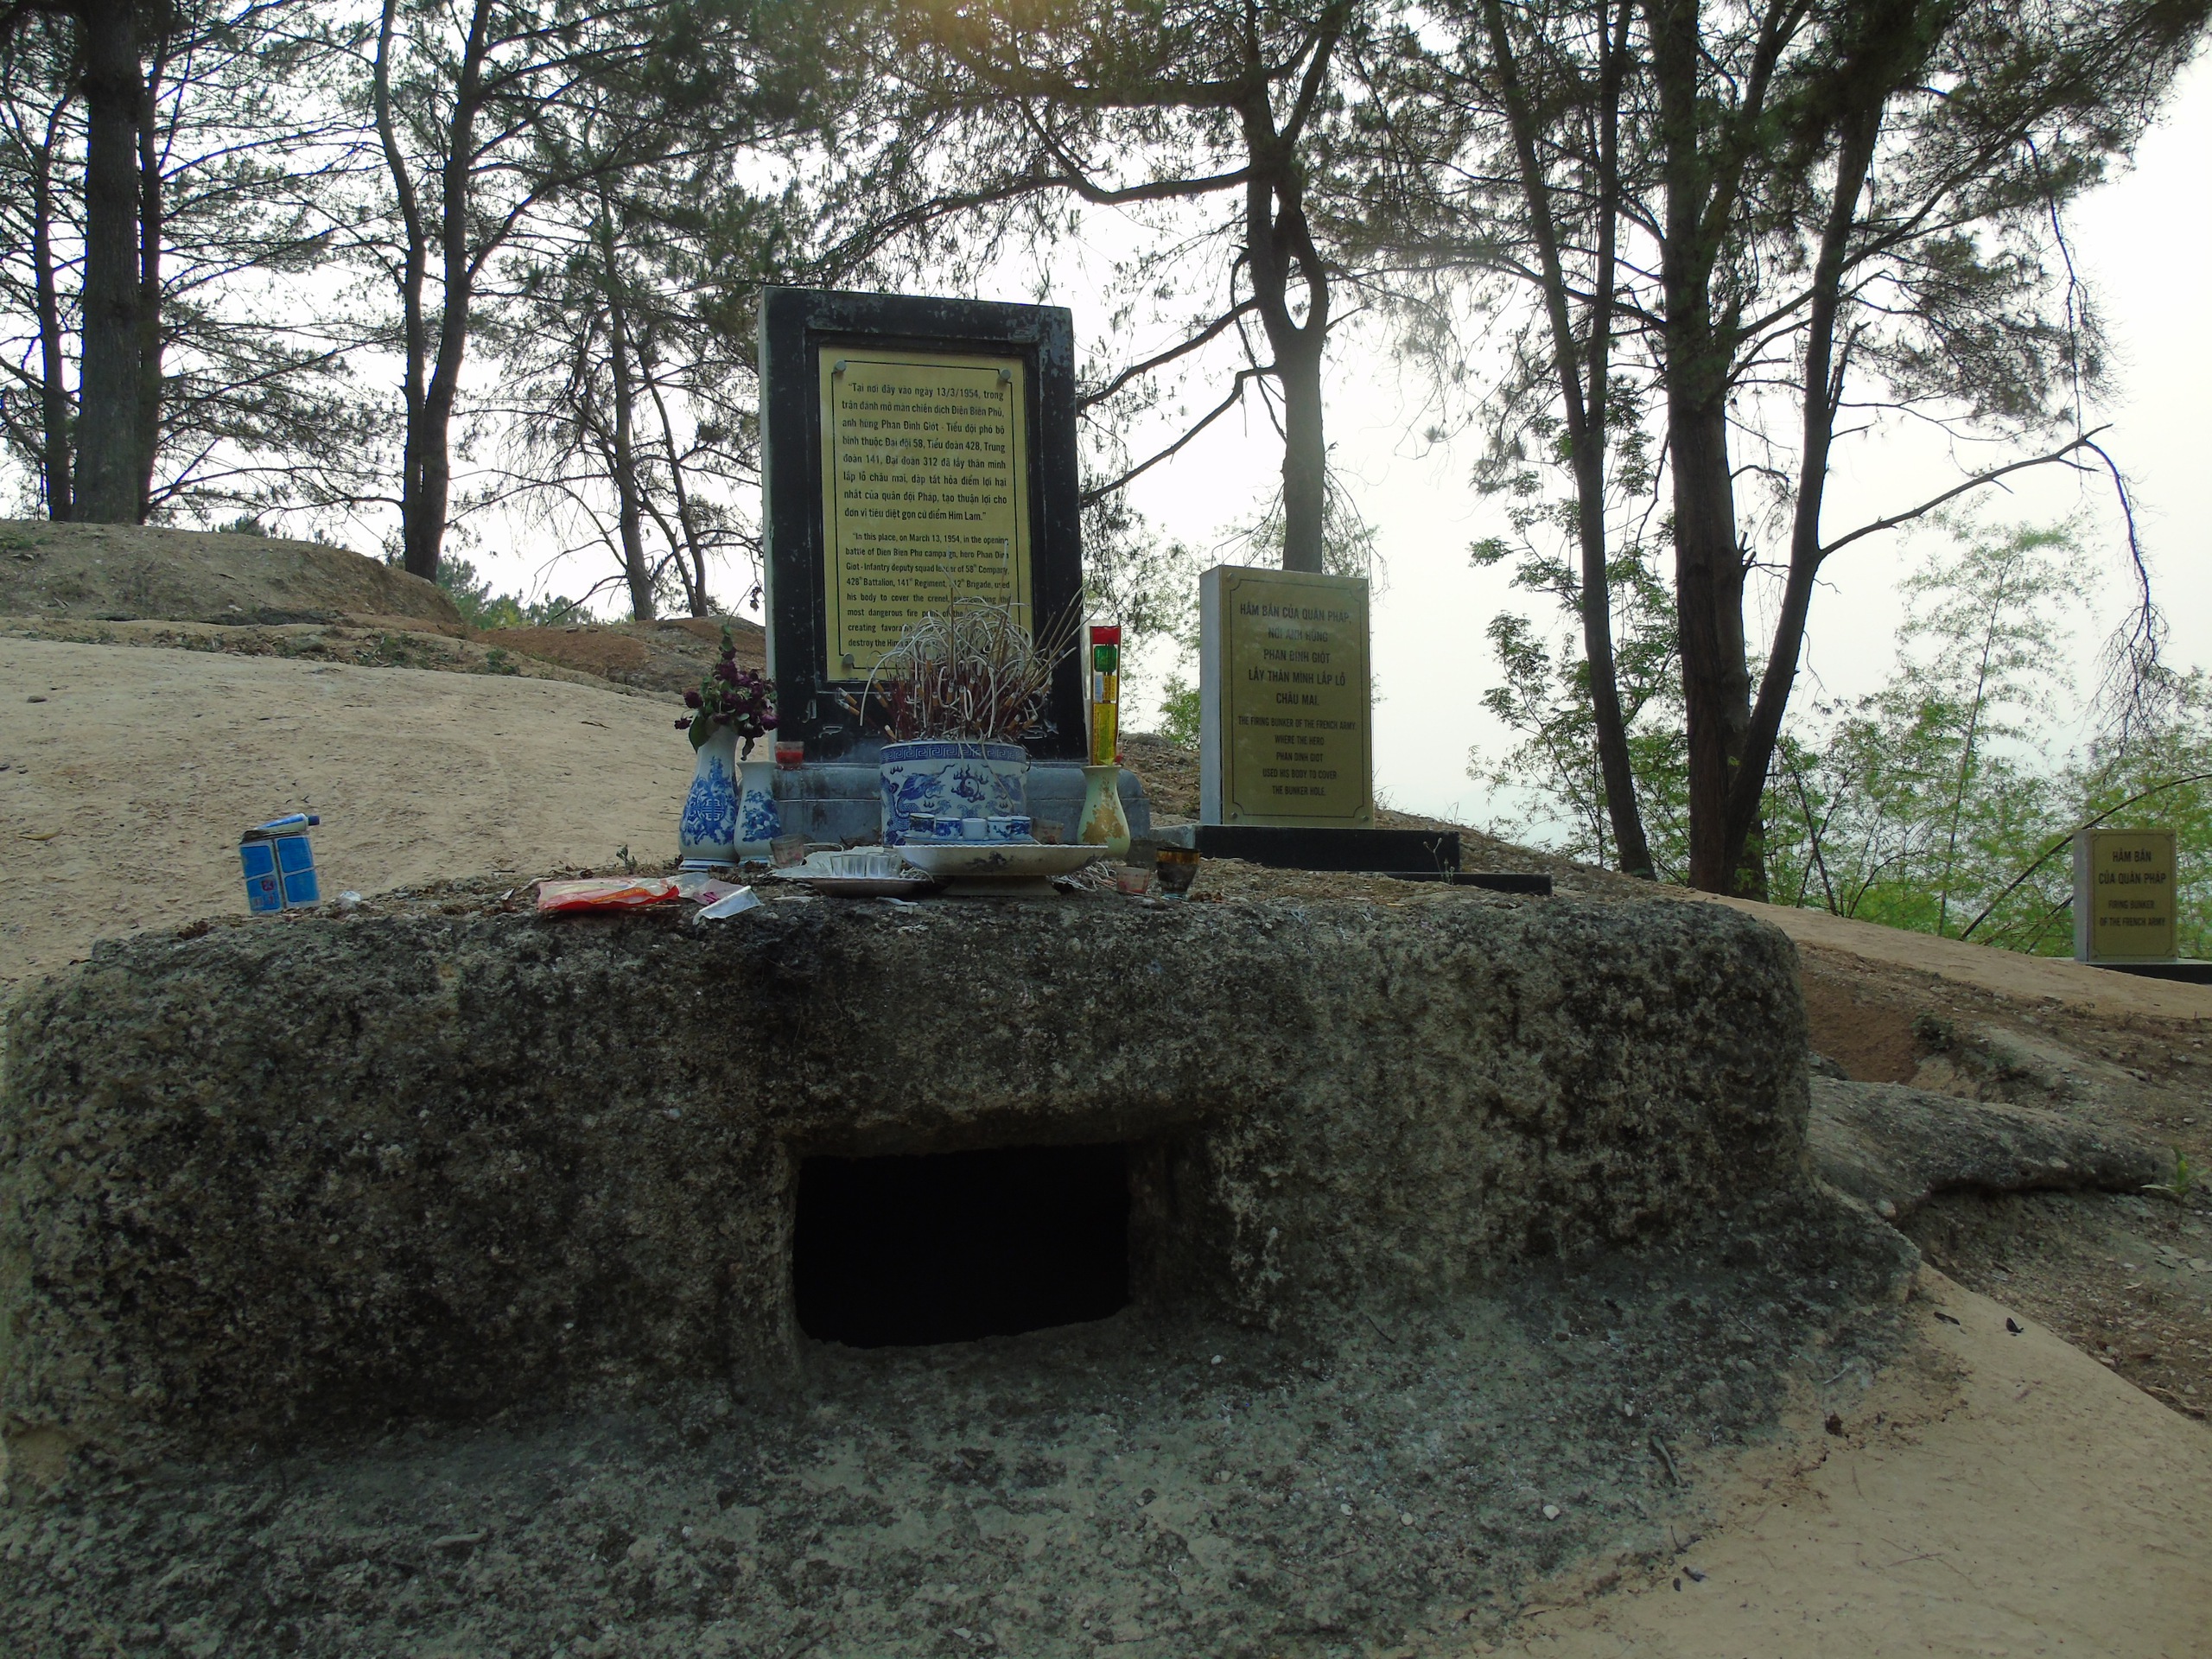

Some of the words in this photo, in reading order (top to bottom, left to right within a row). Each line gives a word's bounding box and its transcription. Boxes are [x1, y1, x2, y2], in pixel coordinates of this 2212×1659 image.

[867, 384, 879, 392] nơi
[881, 385, 895, 396] đây
[898, 385, 912, 395] vào
[914, 386, 933, 397] ngày
[937, 387, 981, 399] 13/3/1954,
[983, 390, 1004, 402] trong
[934, 404, 950, 416] dịch
[951, 404, 968, 416] Điện
[842, 418, 856, 428] anh
[881, 419, 900, 429] Phan
[923, 421, 938, 432] Giót
[979, 423, 993, 435] phó
[861, 436, 883, 448] thuộc
[885, 437, 898, 448] Đại
[913, 439, 925, 449] 58,
[945, 440, 963, 450] đoàn
[965, 441, 982, 452] 428,
[984, 442, 1005, 454] Trung
[843, 453, 862, 463] đoàn
[866, 454, 882, 465] 141,
[886, 454, 898, 466] Đại
[901, 455, 920, 466] đoàn
[923, 457, 938, 467] 312
[941, 457, 950, 467] đã
[968, 458, 985, 468] thân
[869, 473, 888, 482] châu
[892, 474, 908, 484] mai,
[982, 476, 992, 486] lợi
[881, 490, 900, 501] quân
[918, 492, 939, 503] Pháp,
[942, 493, 955, 503] tạo
[982, 494, 991, 504] lợi
[994, 495, 1007, 504] cho
[885, 508, 900, 520] diệt
[949, 511, 963, 520] Him
[878, 533, 898, 543] place,
[931, 535, 942, 543] 13,
[845, 547, 866, 556] battle
[876, 548, 892, 556] Dien
[910, 549, 923, 557] Phu
[846, 563, 860, 571] Giot
[864, 563, 890, 573] Infantry
[892, 563, 913, 573] deputy
[915, 564, 935, 573] squad
[863, 578, 896, 588] Battalion,
[914, 579, 947, 589] Regiment,
[966, 580, 993, 590] Brigade,
[861, 593, 876, 603] body
[913, 594, 924, 602] the
[868, 609, 903, 620] dangerous
[1282, 603, 1300, 620] CỦA
[848, 624, 876, 632] creating
[849, 638, 874, 648] destroy
[1263, 648, 1287, 661] PHAN
[1268, 669, 1290, 683] THÂN
[1237, 716, 1249, 726] THE
[1250, 716, 1269, 727] FIRING
[1271, 717, 1294, 728] BUNKER
[1295, 719, 1303, 728] OF
[1304, 719, 1315, 728] THE
[1316, 719, 1338, 729] FRENCH
[1274, 734, 1294, 745] WHERE
[1296, 735, 1307, 745] THE
[1309, 736, 1325, 746] HERO
[1275, 752, 1293, 761] PHAN
[1294, 752, 1309, 762] DINH
[1310, 753, 1323, 763] GIOT
[1262, 768, 1278, 778] USED
[1279, 769, 1289, 779] HIS
[1291, 769, 1307, 779] BODY
[1309, 770, 1317, 779] TO
[1318, 770, 1338, 780] COVER
[1272, 785, 1283, 795] THE
[1285, 785, 1308, 796] BUNKER
[2099, 870, 2115, 885] CỦA
[2145, 872, 2166, 885] PHÁP
